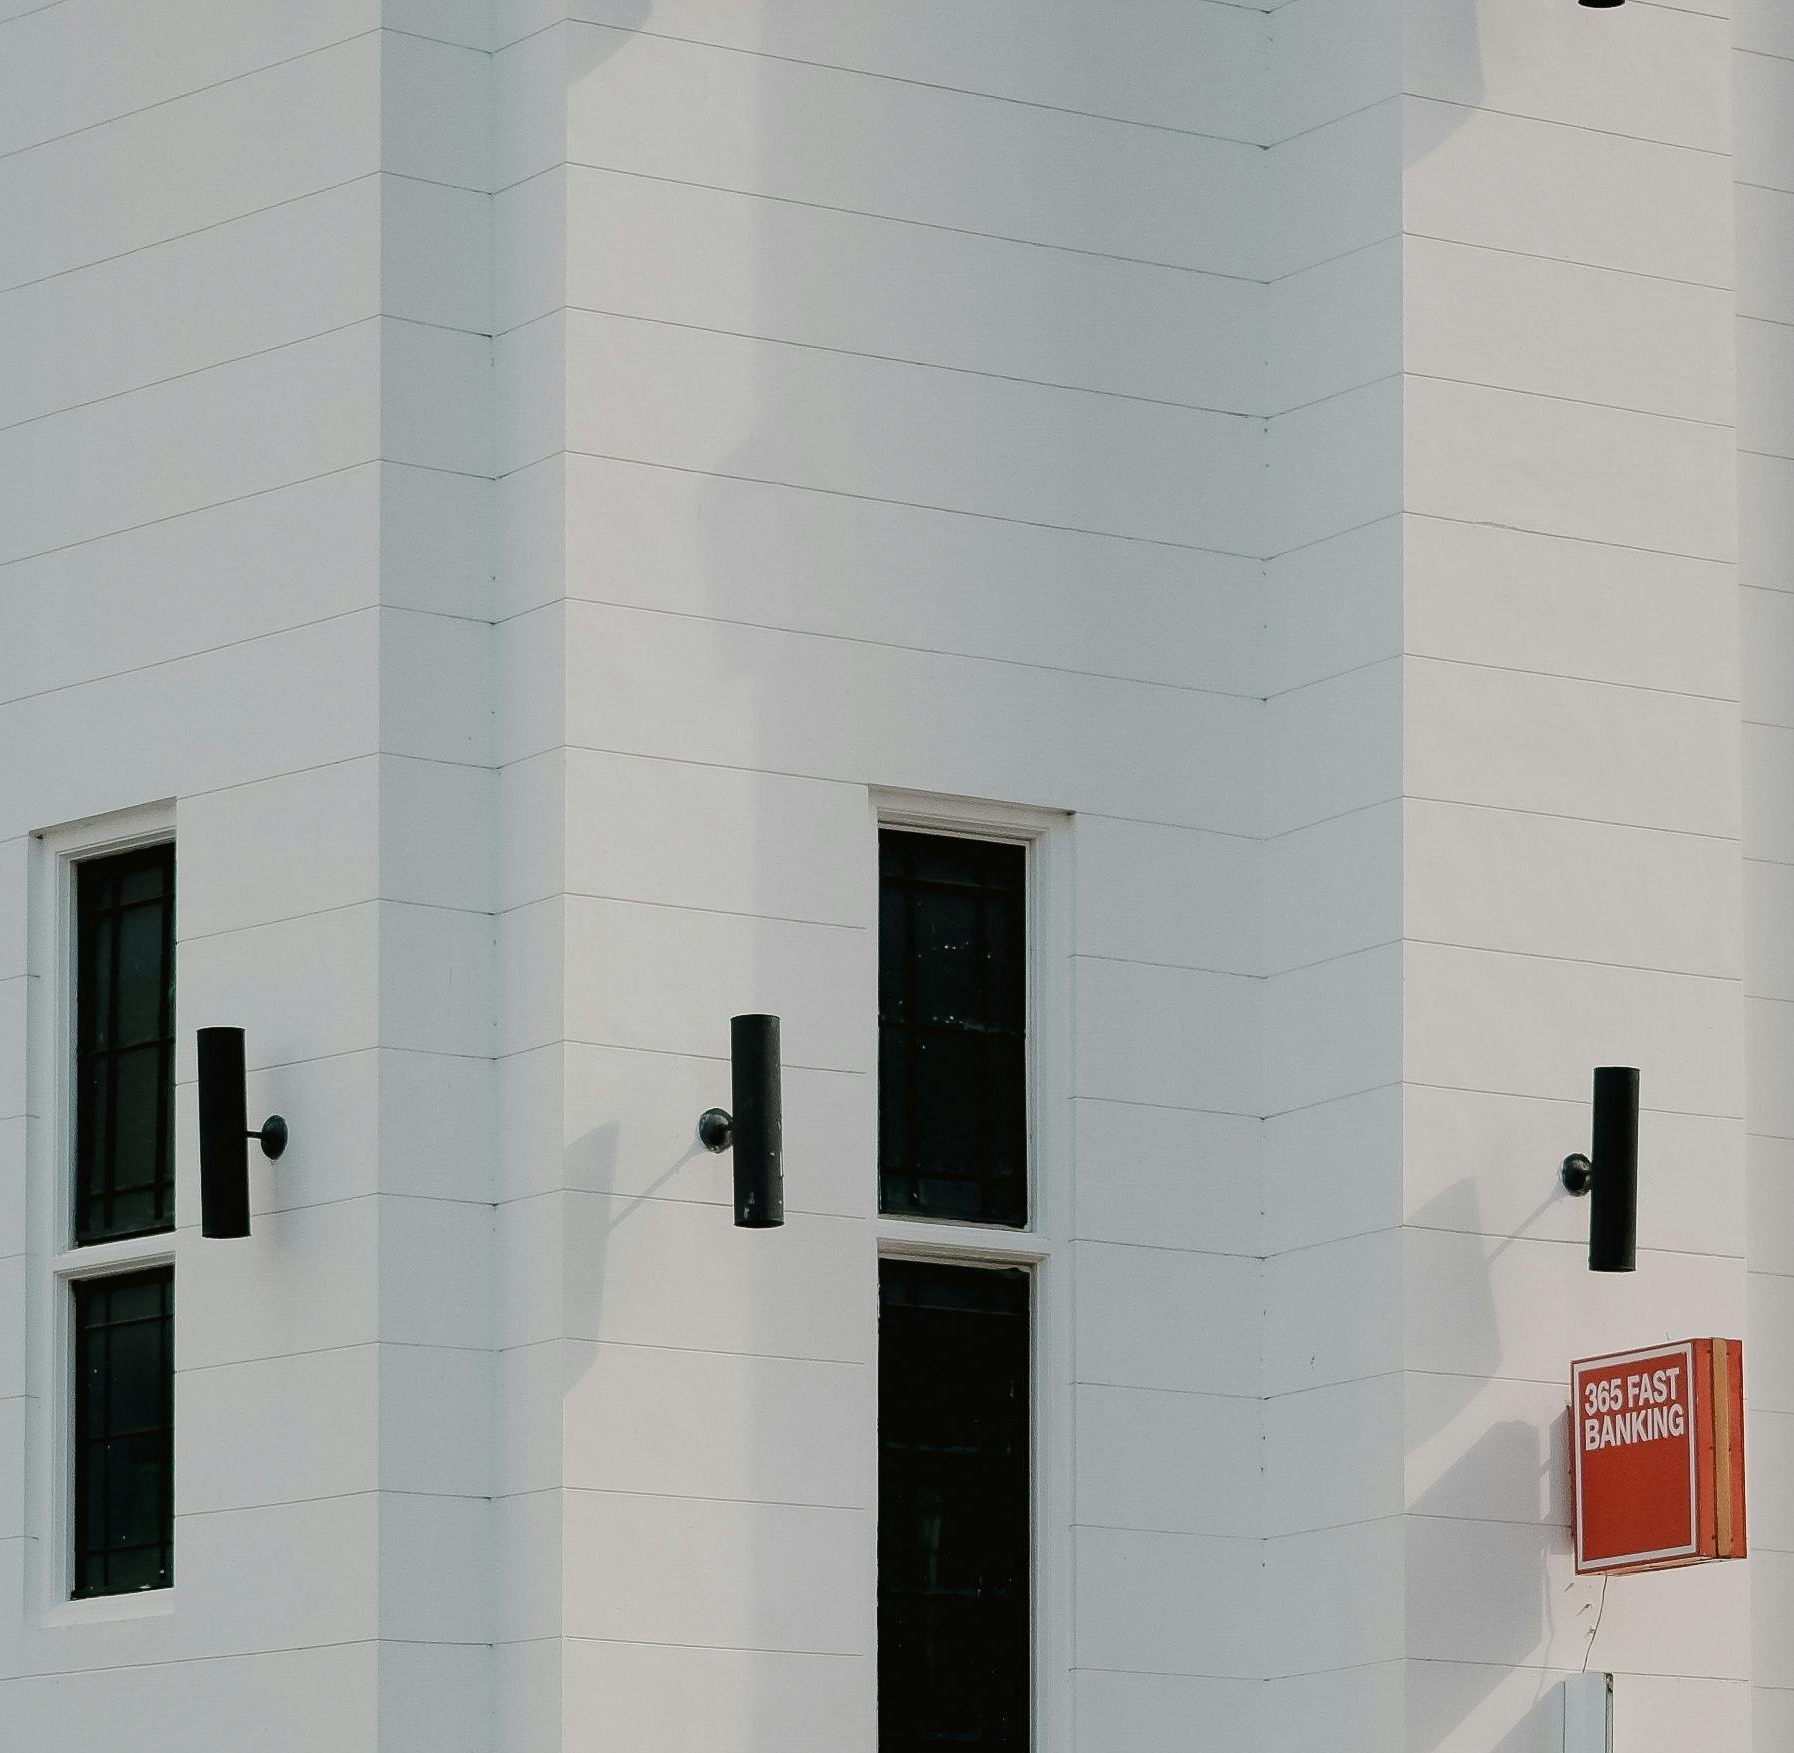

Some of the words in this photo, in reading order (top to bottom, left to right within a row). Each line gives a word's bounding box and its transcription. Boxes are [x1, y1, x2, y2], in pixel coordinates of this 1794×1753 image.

[1584, 1378, 1623, 1417] 365
[1627, 1367, 1681, 1408] FAST
[1585, 1404, 1685, 1451] BANKING
